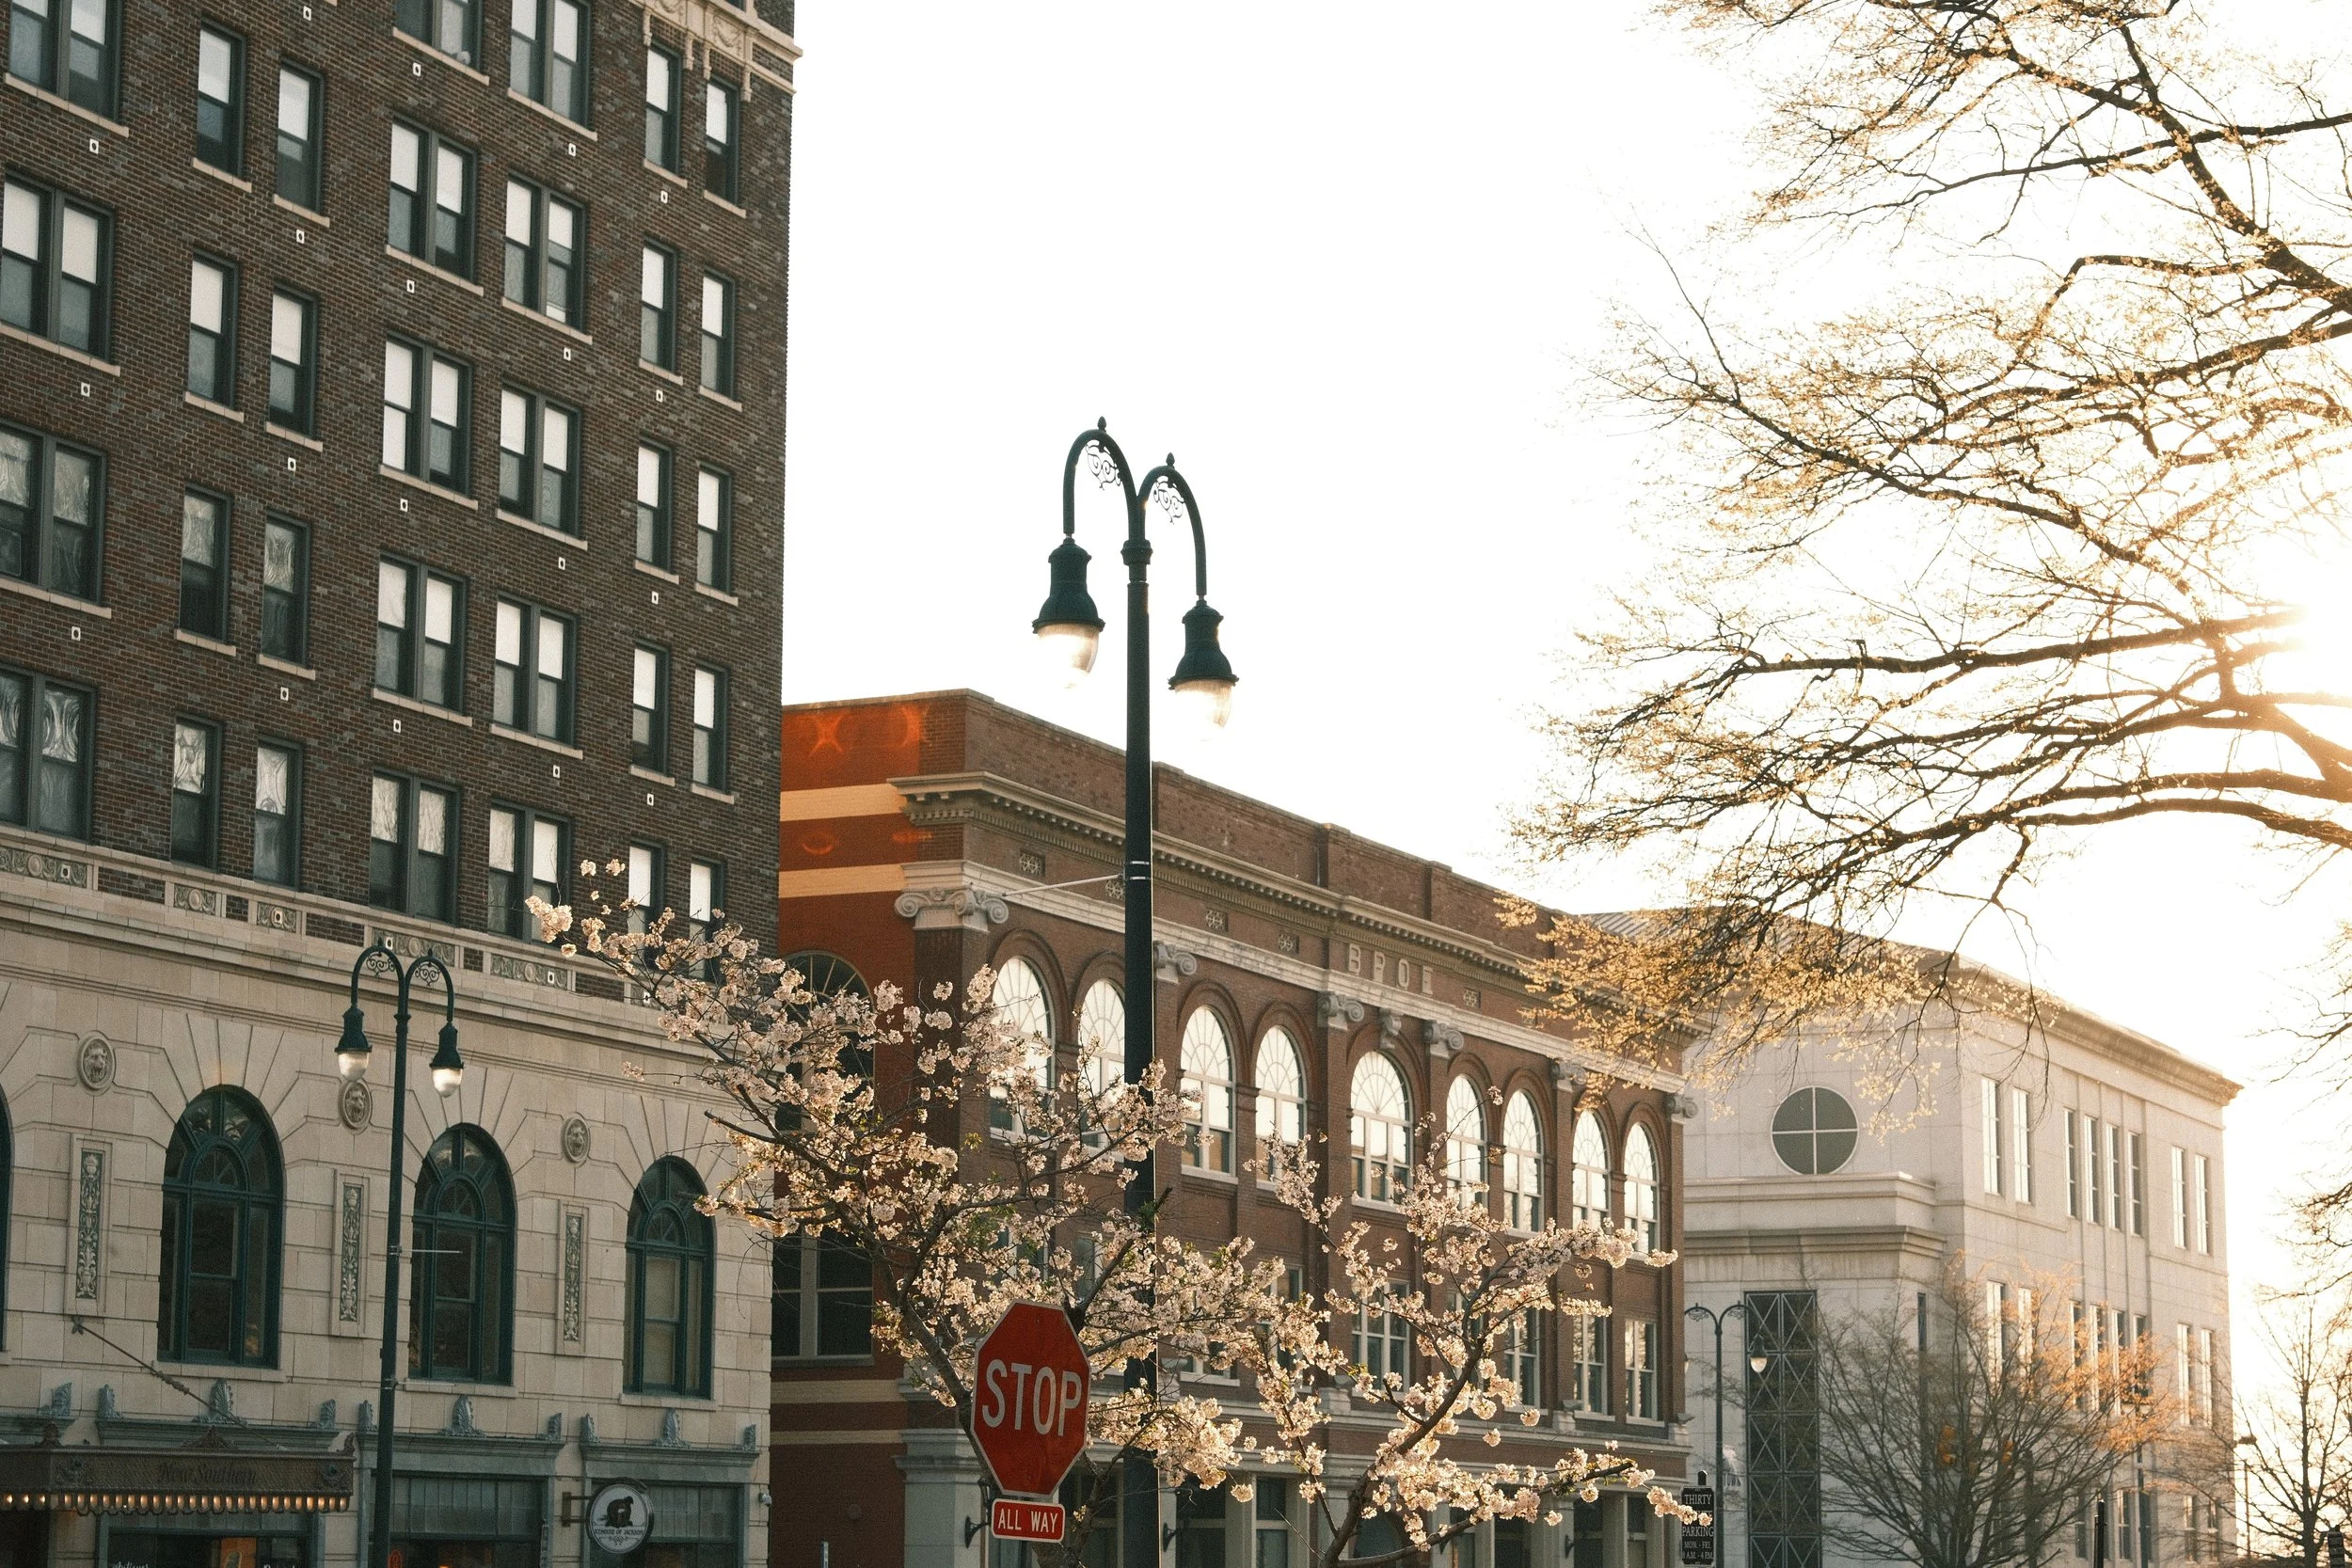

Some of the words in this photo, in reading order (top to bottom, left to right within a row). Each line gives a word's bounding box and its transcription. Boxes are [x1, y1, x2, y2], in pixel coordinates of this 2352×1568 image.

[981, 1358, 1082, 1437] STOP
[157, 1461, 193, 1483] New
[194, 1462, 257, 1485] Southern
[1684, 1495, 1711, 1504] THIRTY
[997, 1507, 1022, 1531] ALL
[1029, 1510, 1058, 1534] WAY
[1682, 1527, 1714, 1536] PARKING
[1684, 1541, 1698, 1549] MON.
